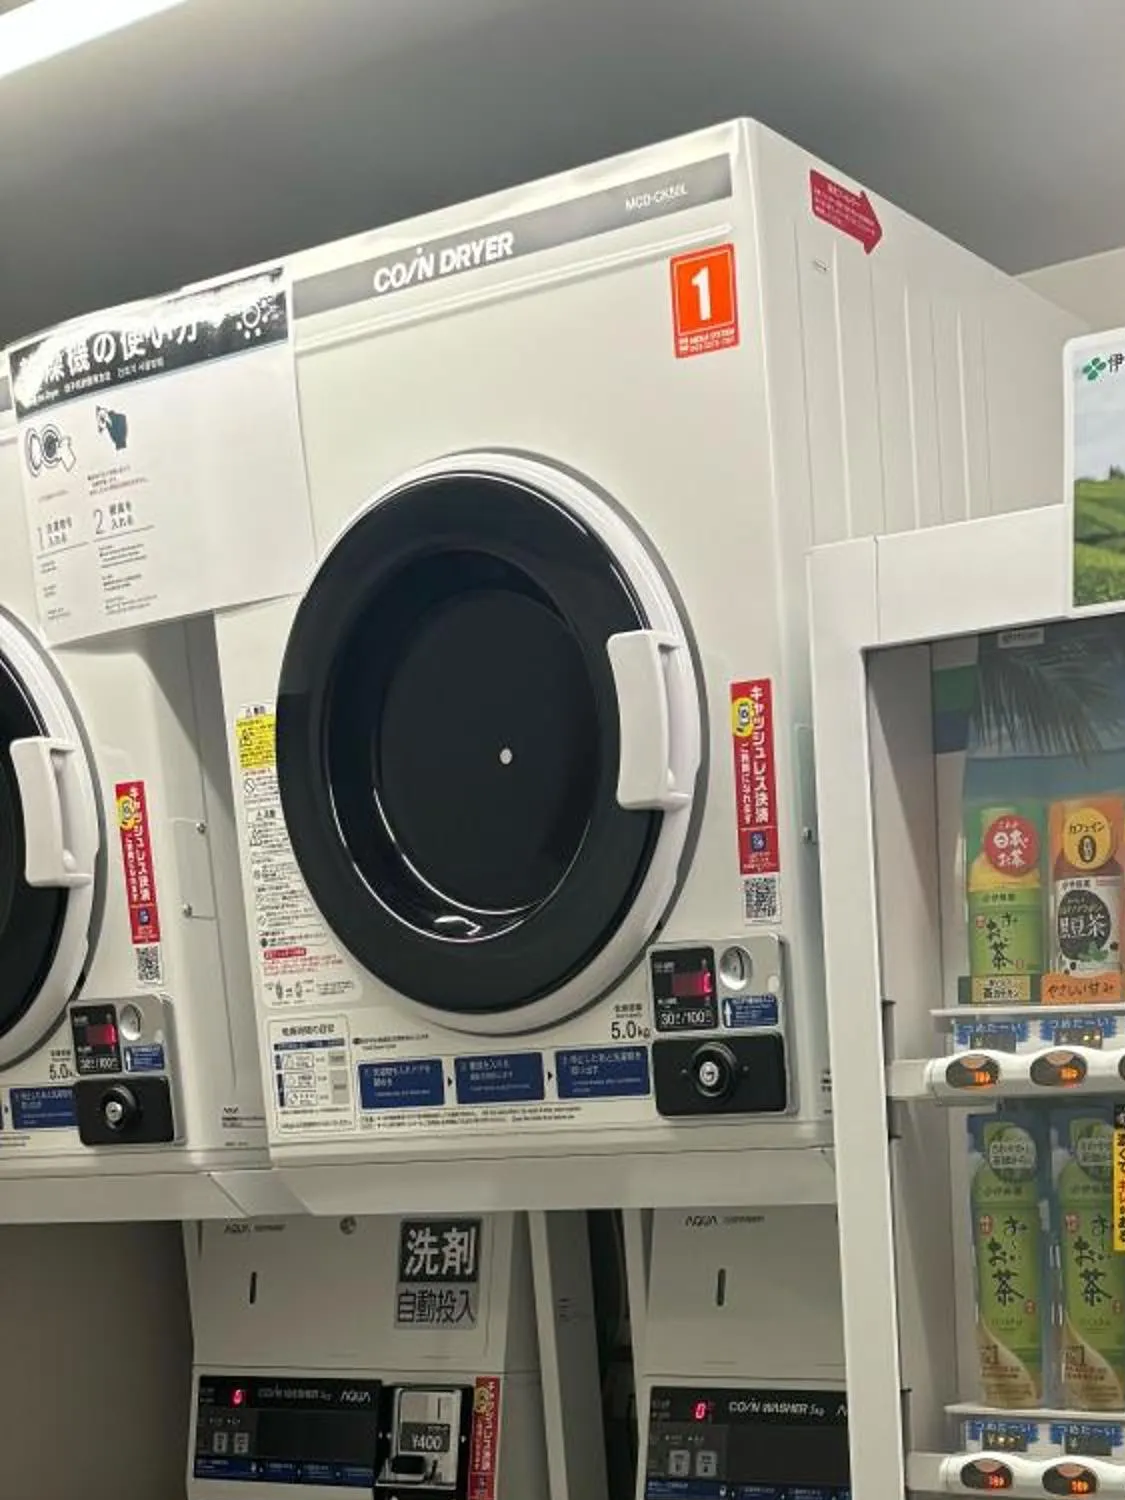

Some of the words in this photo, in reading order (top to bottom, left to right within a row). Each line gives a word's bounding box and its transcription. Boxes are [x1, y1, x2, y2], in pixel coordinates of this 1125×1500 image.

[373, 246, 435, 293] COIN
[438, 231, 515, 276] DRYER
[691, 266, 711, 321] 1
[1069, 821, 1105, 834] カフェイン
[1047, 982, 1116, 999] やさしい甘み
[404, 1227, 477, 1276] 洗剤
[987, 1236, 1025, 1307] お茶
[1073, 1235, 1113, 1307] お茶
[396, 1289, 476, 1325] 自動投入
[411, 1435, 442, 1451] ¥400
